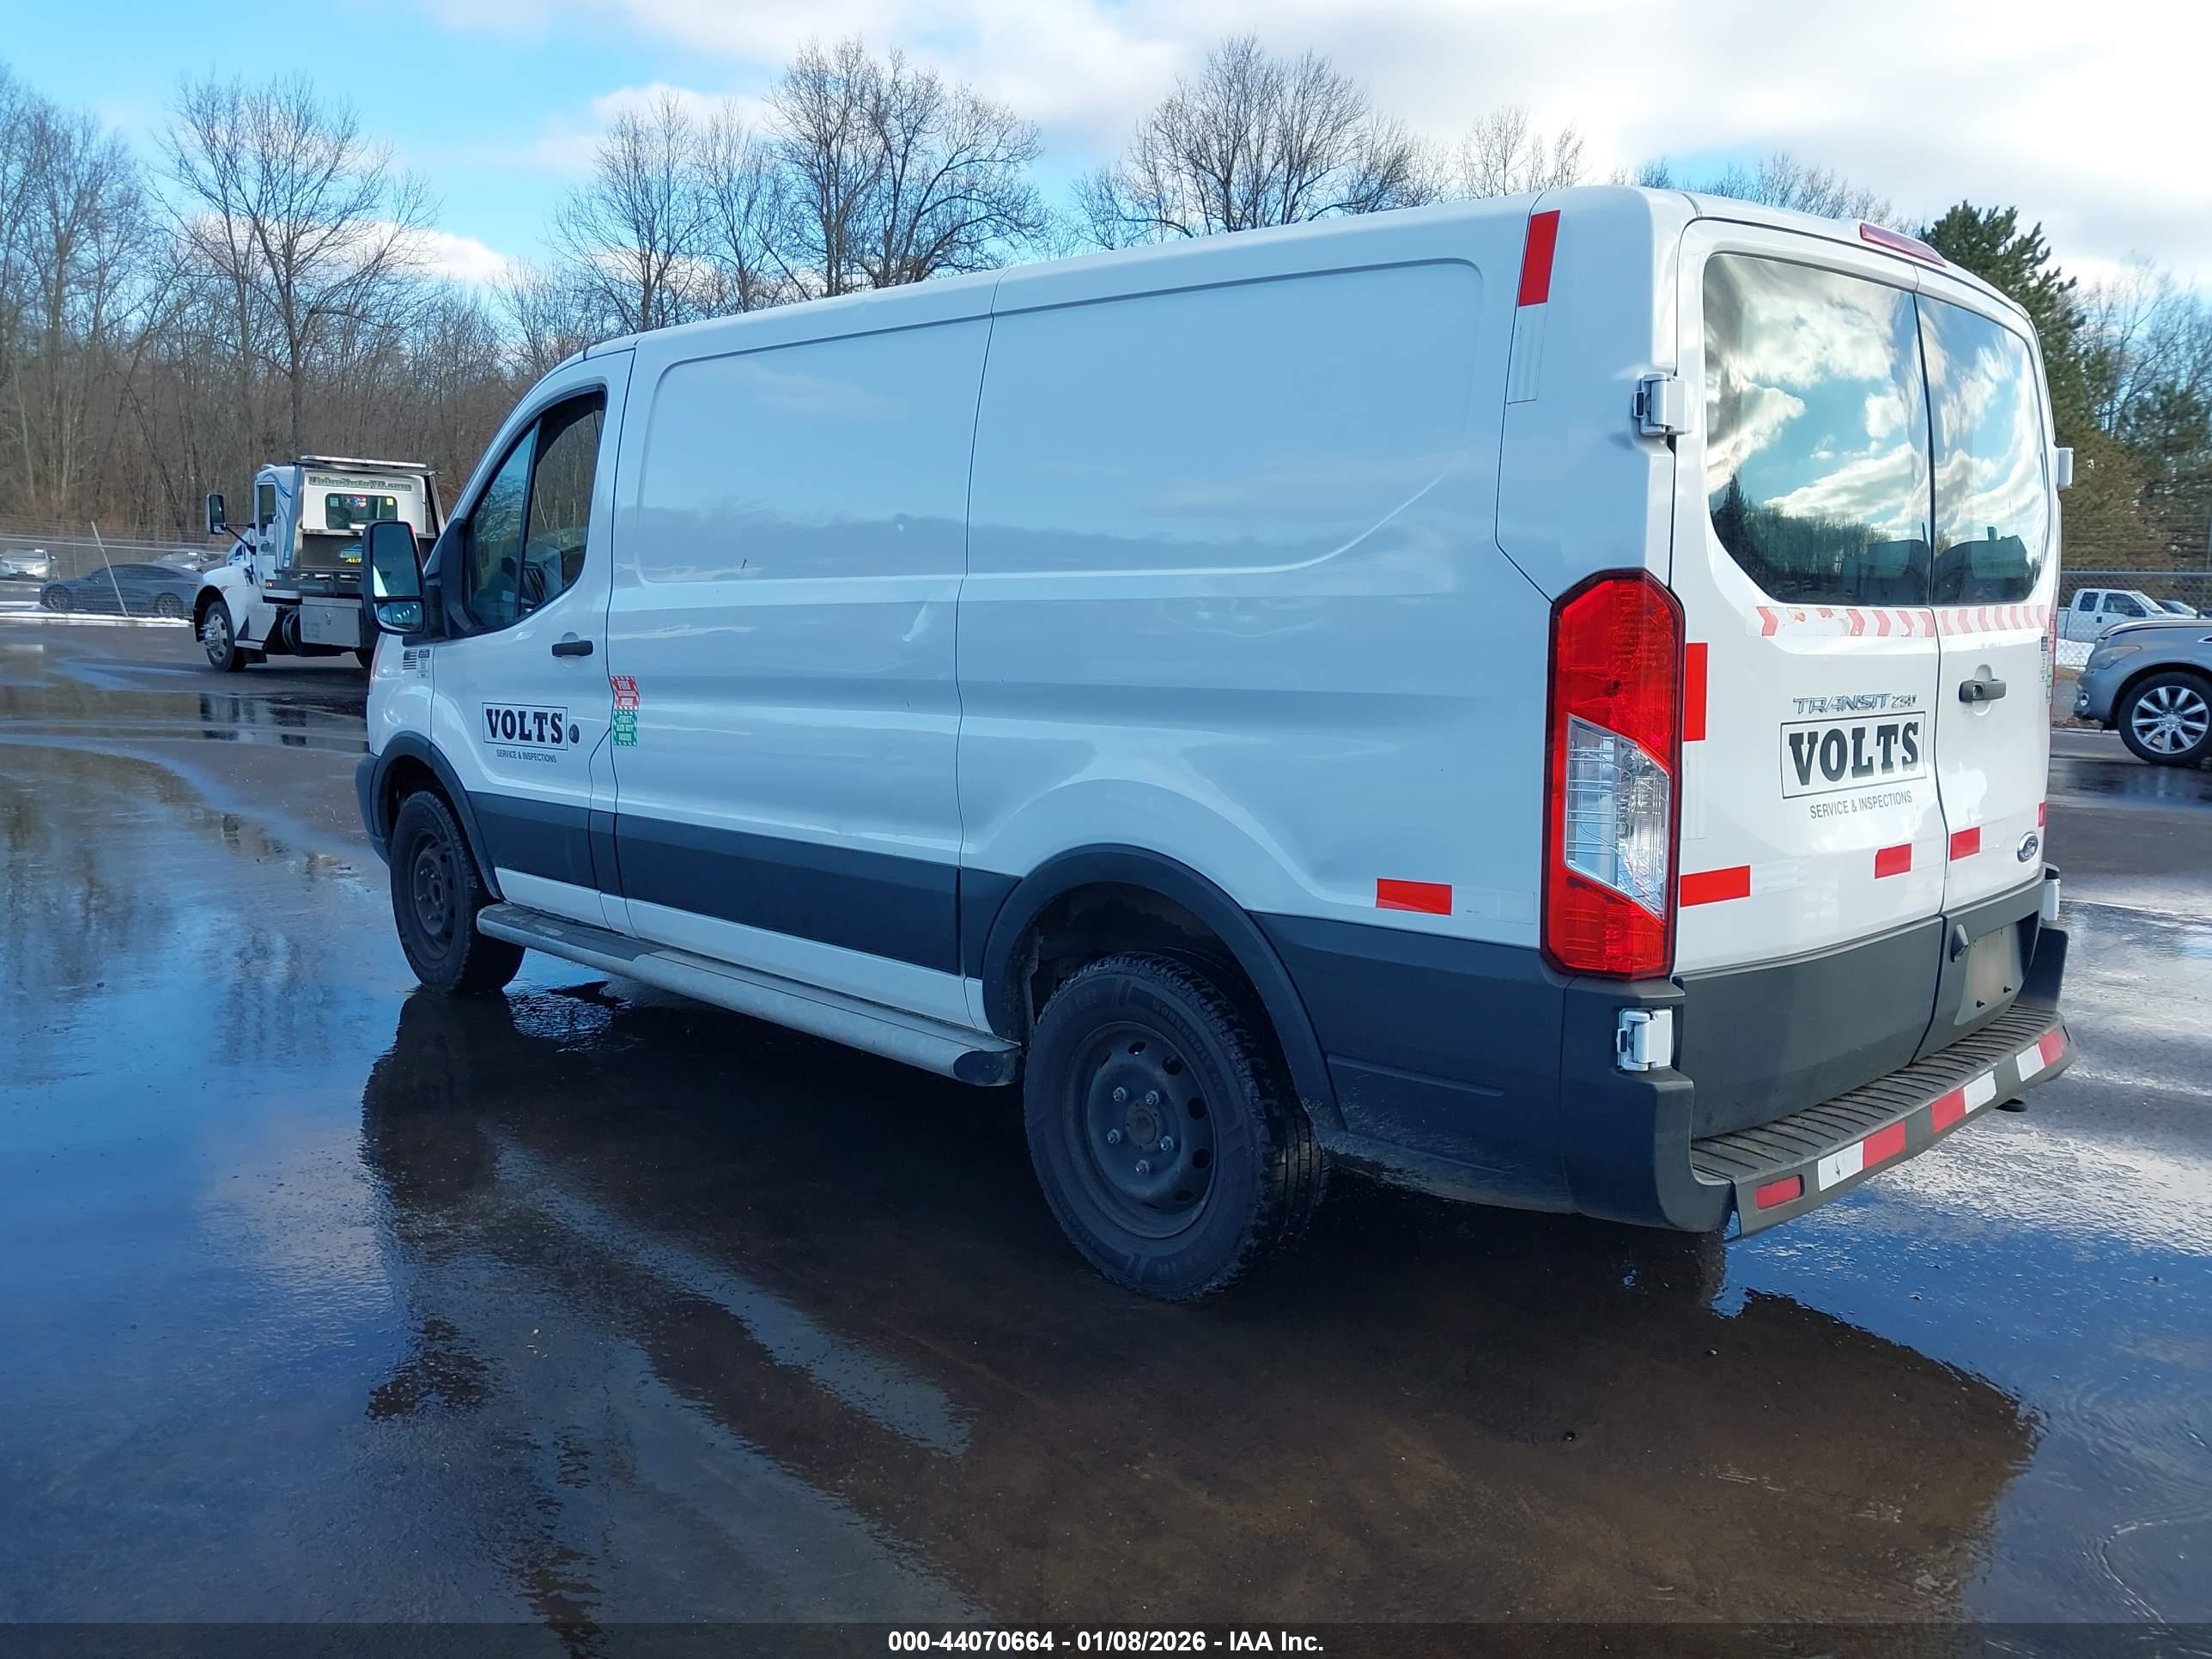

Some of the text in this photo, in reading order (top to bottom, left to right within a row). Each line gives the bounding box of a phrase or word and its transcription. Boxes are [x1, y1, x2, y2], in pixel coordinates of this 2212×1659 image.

[1793, 693, 1892, 714] TRANSIT
[486, 708, 562, 744] VOLTS
[496, 749, 517, 759] SERVICE
[523, 751, 556, 763] INSPECTIONS
[1789, 722, 1919, 786] VOLTS
[1809, 790, 1913, 819] SERVICE & INSPECTIONS
